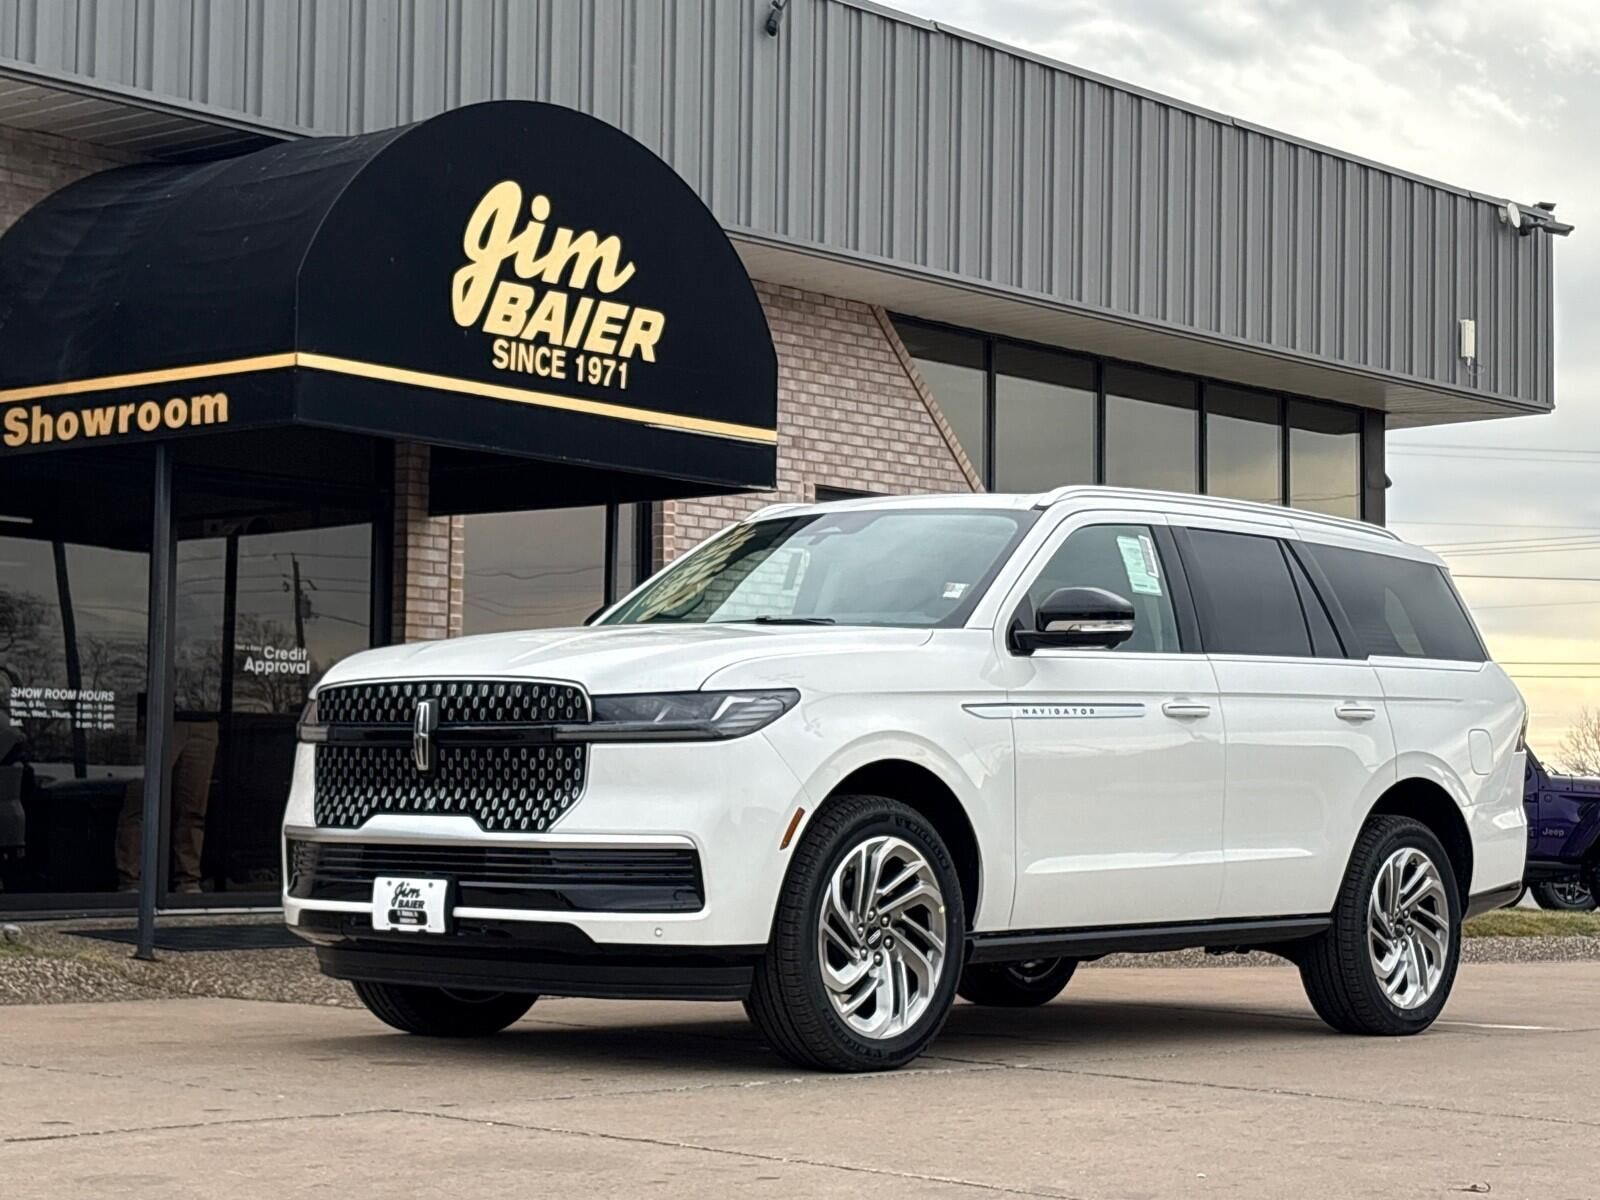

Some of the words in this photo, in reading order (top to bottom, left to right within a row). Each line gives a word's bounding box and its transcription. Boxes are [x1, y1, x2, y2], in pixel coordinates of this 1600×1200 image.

[452, 180, 637, 327] Jim
[482, 280, 665, 363] BAIER
[492, 338, 567, 380] SINCE
[575, 354, 628, 389] 1971
[3, 391, 229, 447] Showroom
[263, 646, 308, 661] Credit
[243, 656, 310, 675] Approval
[10, 687, 42, 699] SHOW
[44, 688, 77, 700] ROOM
[78, 690, 115, 702] HOURS
[1542, 827, 1565, 838] Jeep
[391, 881, 421, 907] Jim
[398, 899, 425, 909] BAIER
